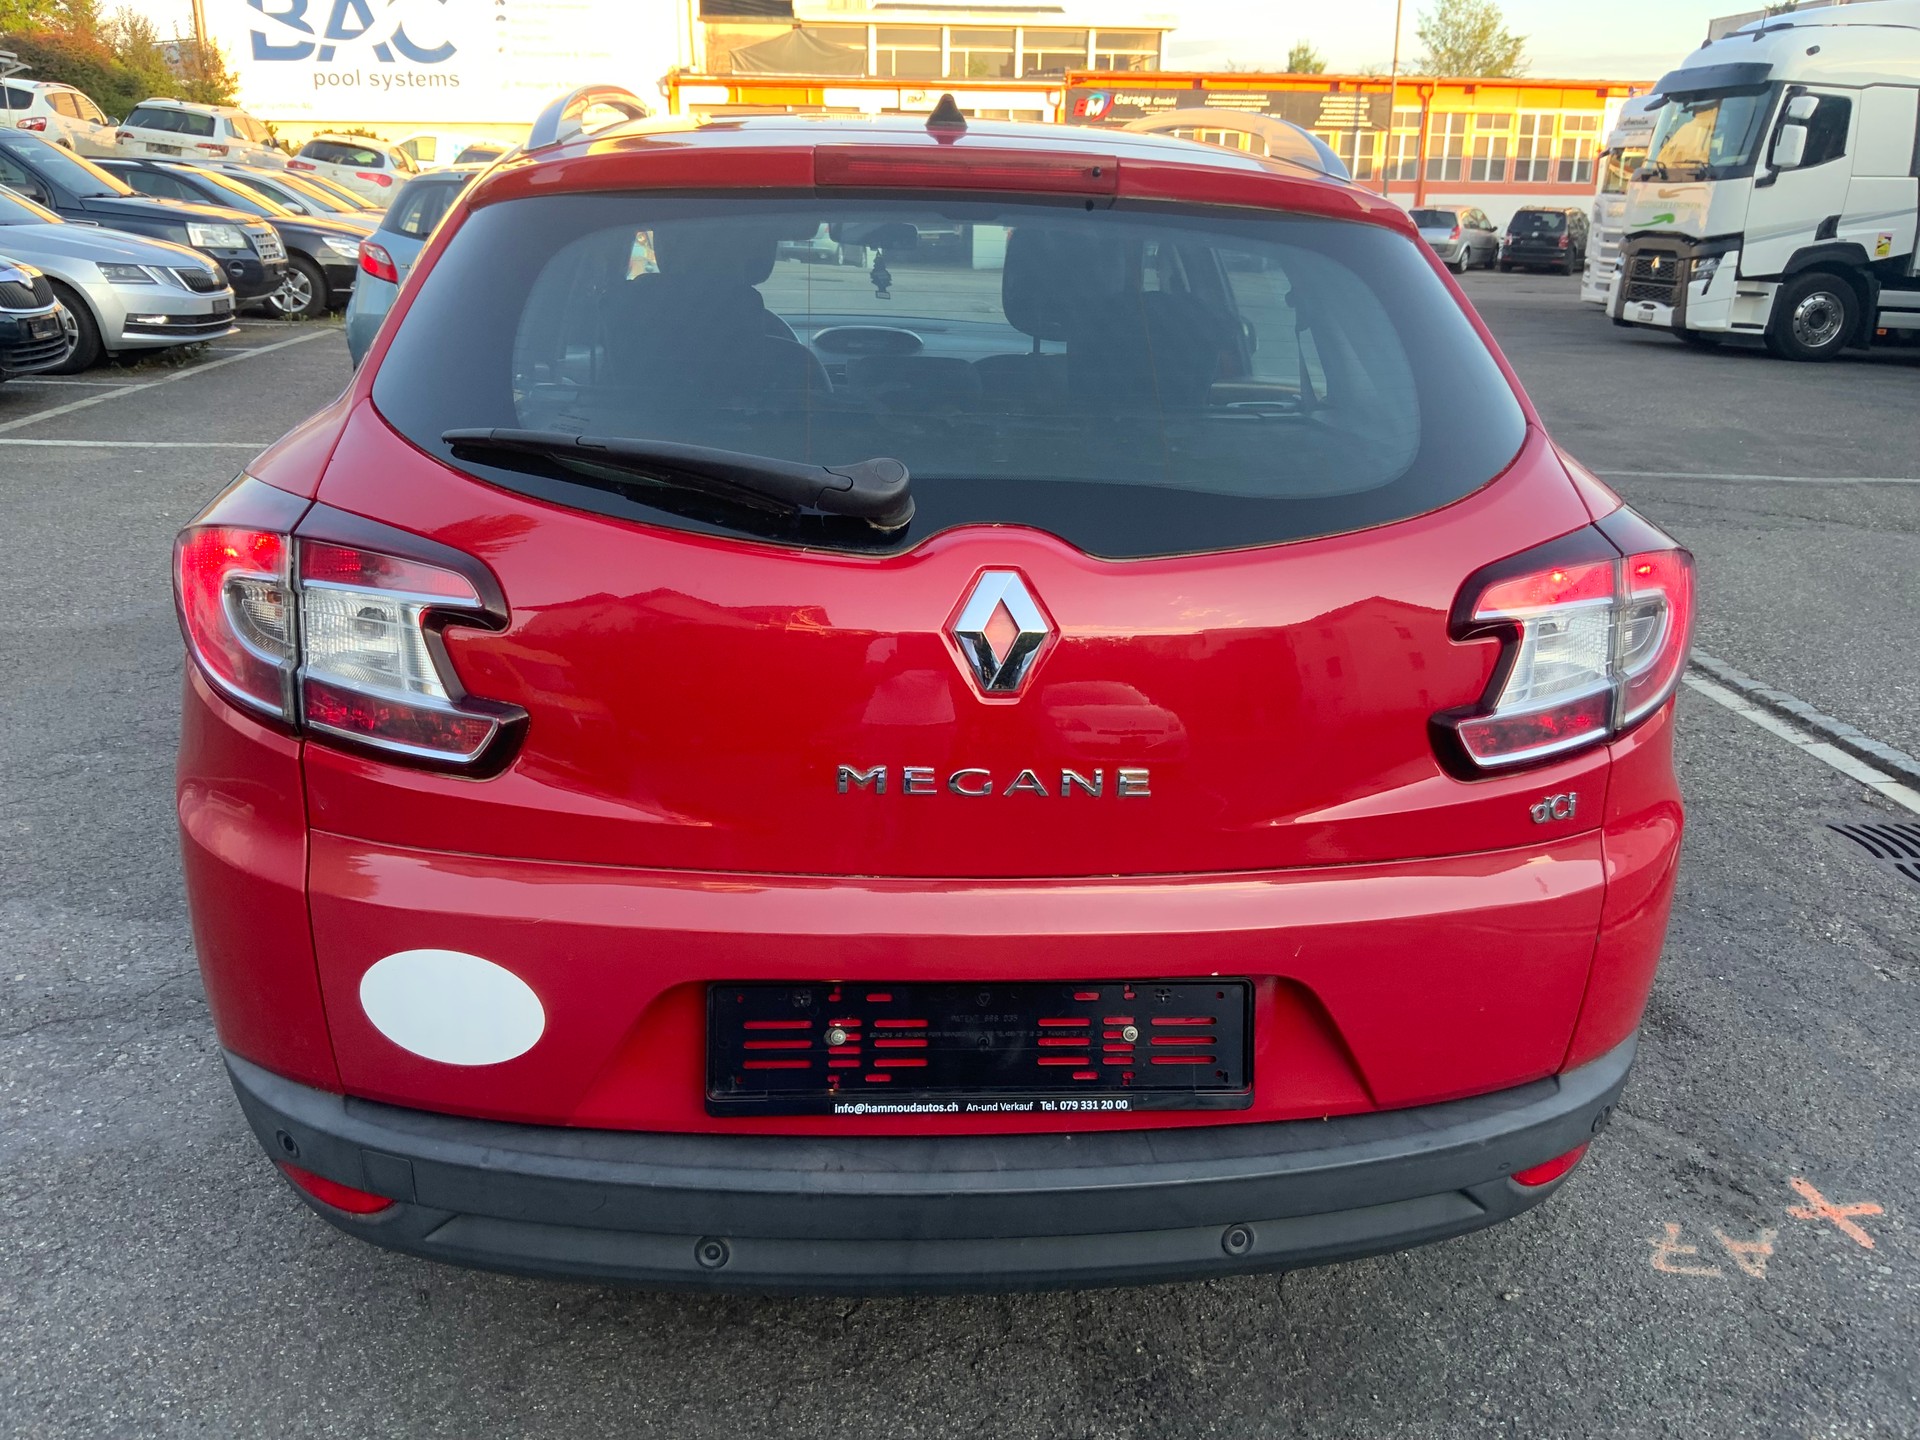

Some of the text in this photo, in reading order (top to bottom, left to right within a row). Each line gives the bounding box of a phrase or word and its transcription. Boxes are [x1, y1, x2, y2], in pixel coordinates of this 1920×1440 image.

[313, 69, 460, 91] pool systems
[1113, 93, 1152, 107] Garage
[836, 765, 1152, 798] MEGANE
[1530, 792, 1577, 824] dCi
[834, 1099, 1128, 1115] info@hammoudautos.ch An-und Verkauf Tel. 079 331 20 00
